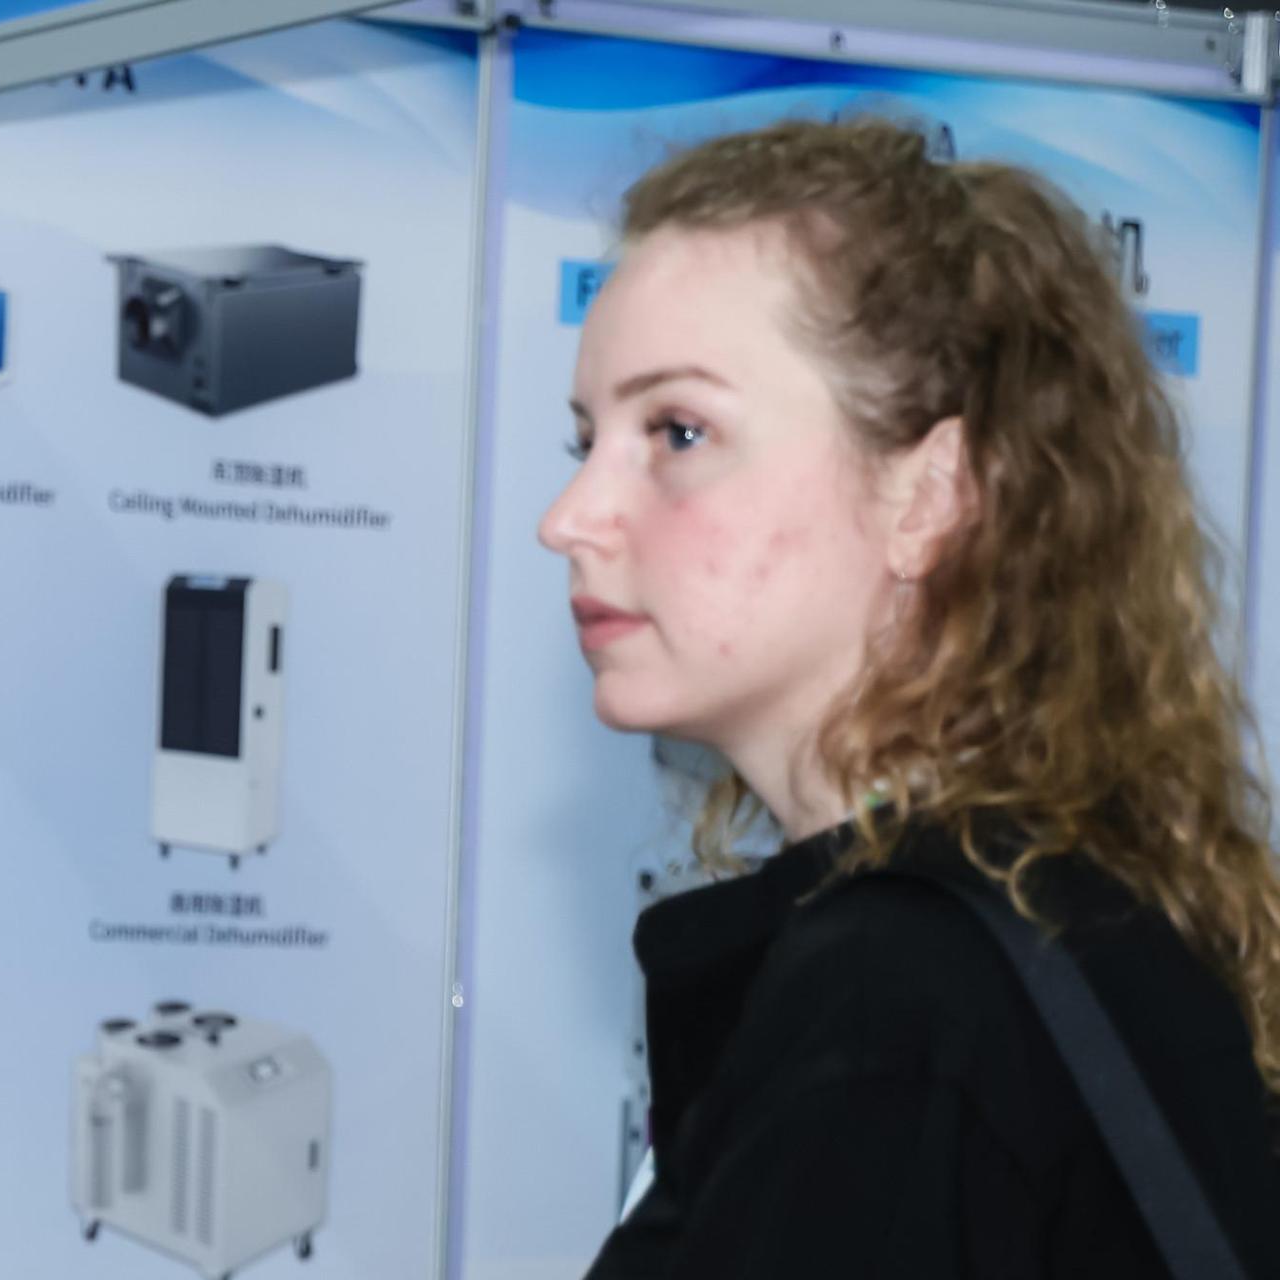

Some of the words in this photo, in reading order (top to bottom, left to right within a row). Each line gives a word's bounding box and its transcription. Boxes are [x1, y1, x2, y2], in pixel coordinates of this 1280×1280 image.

[109, 490, 175, 522] Ceiling
[179, 496, 258, 522] Mounted
[266, 503, 392, 530] Dehumidifier
[90, 921, 200, 945] Commercial
[207, 925, 329, 948] Dehumidifier
